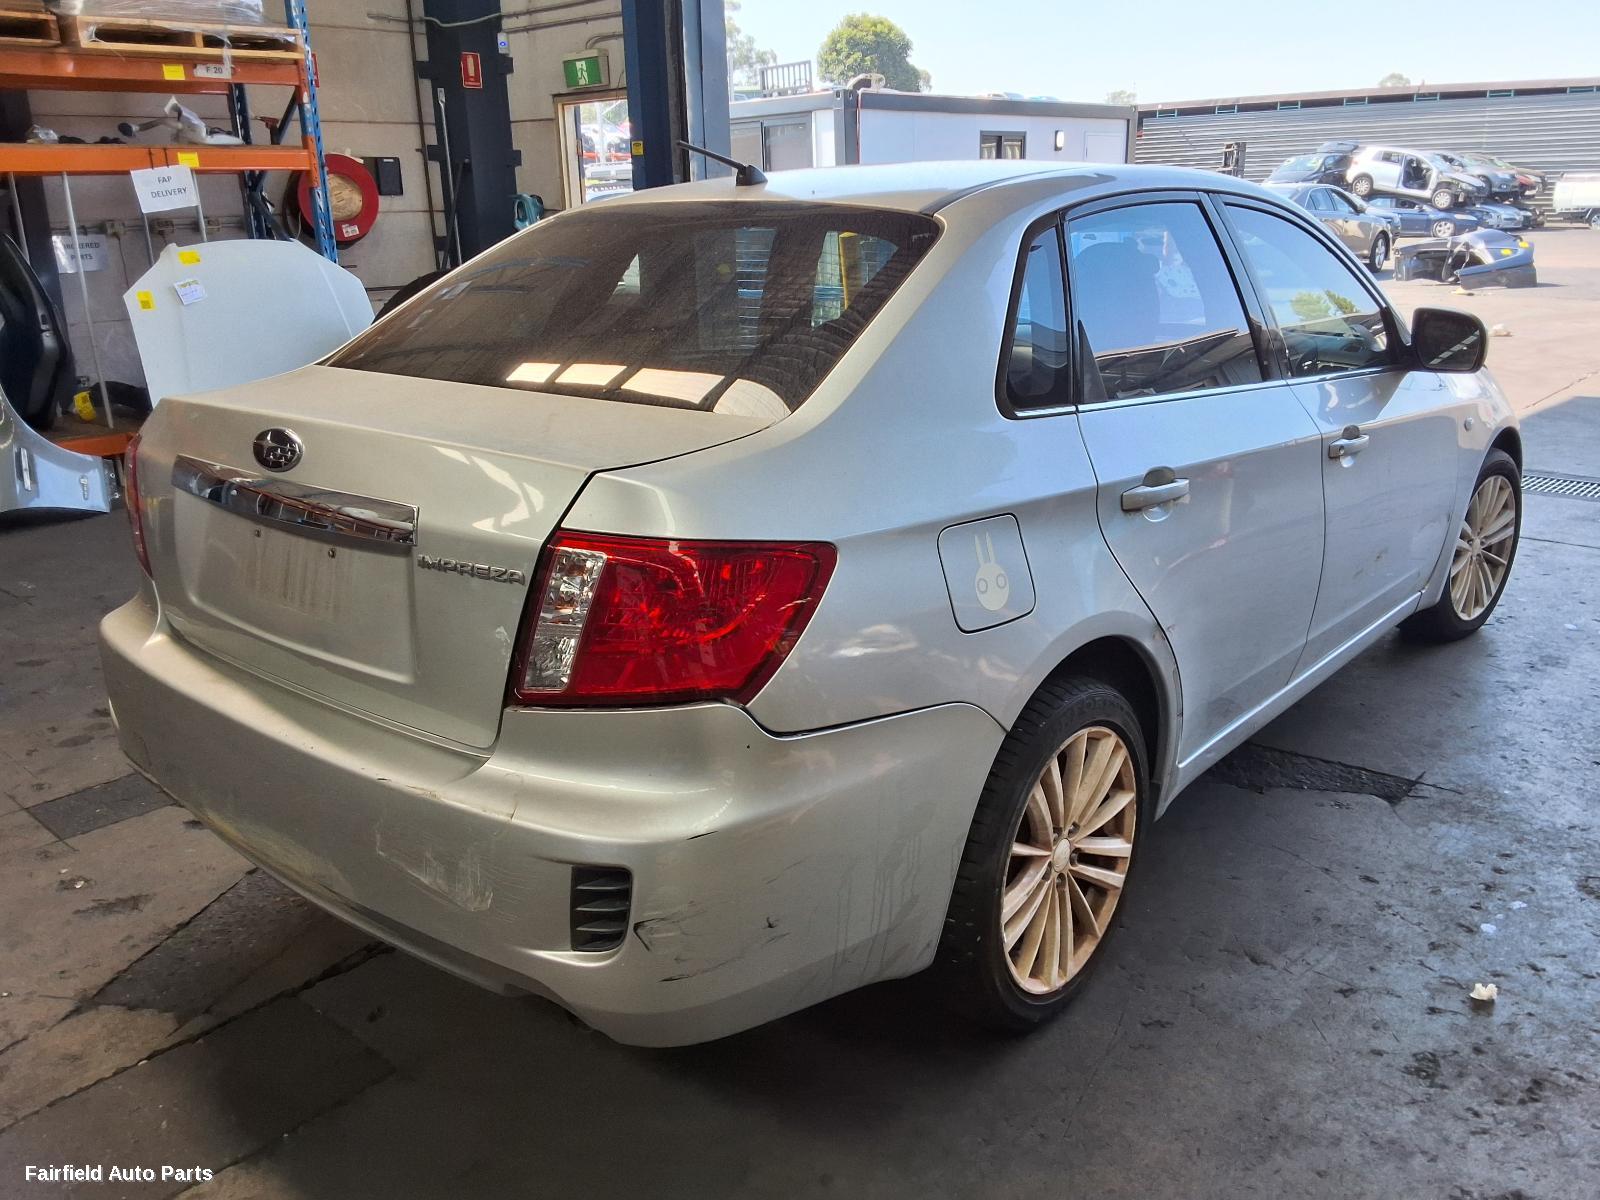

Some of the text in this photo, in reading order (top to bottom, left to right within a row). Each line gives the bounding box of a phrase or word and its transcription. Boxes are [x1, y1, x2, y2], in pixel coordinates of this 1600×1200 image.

[213, 66, 223, 74] 20
[157, 175, 172, 184] FAP
[150, 186, 187, 199] DELIVERY
[70, 253, 93, 261] PRTS
[418, 554, 526, 586] IMPREZA
